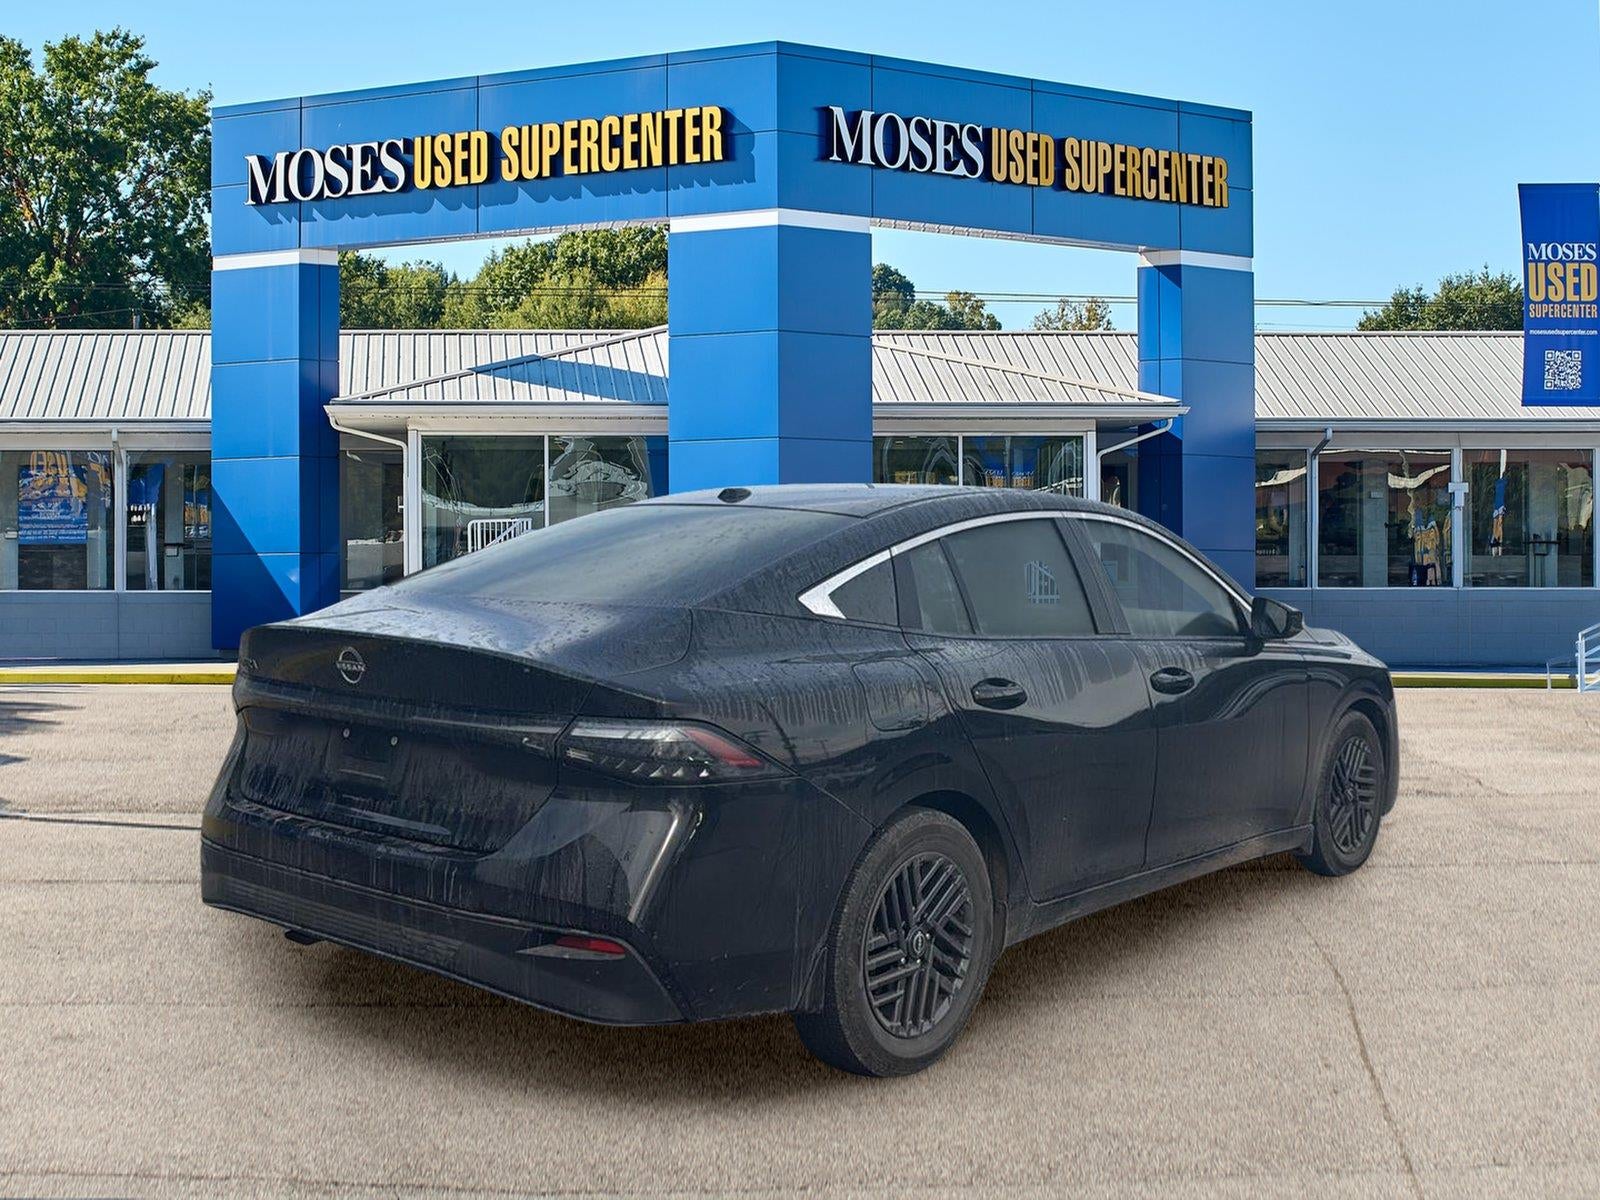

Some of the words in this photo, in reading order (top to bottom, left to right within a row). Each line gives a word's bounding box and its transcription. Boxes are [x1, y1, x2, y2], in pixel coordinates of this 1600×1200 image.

[244, 139, 407, 206] MOSES
[412, 130, 489, 190] USED
[500, 105, 724, 182] SUPERCENTER
[828, 106, 985, 179] MOSES
[991, 128, 1056, 187] USED
[1065, 138, 1231, 209] SUPERCENTER
[1527, 243, 1597, 261] MOSES
[1528, 262, 1598, 302] USED
[1529, 303, 1598, 318] SUPERCENTER
